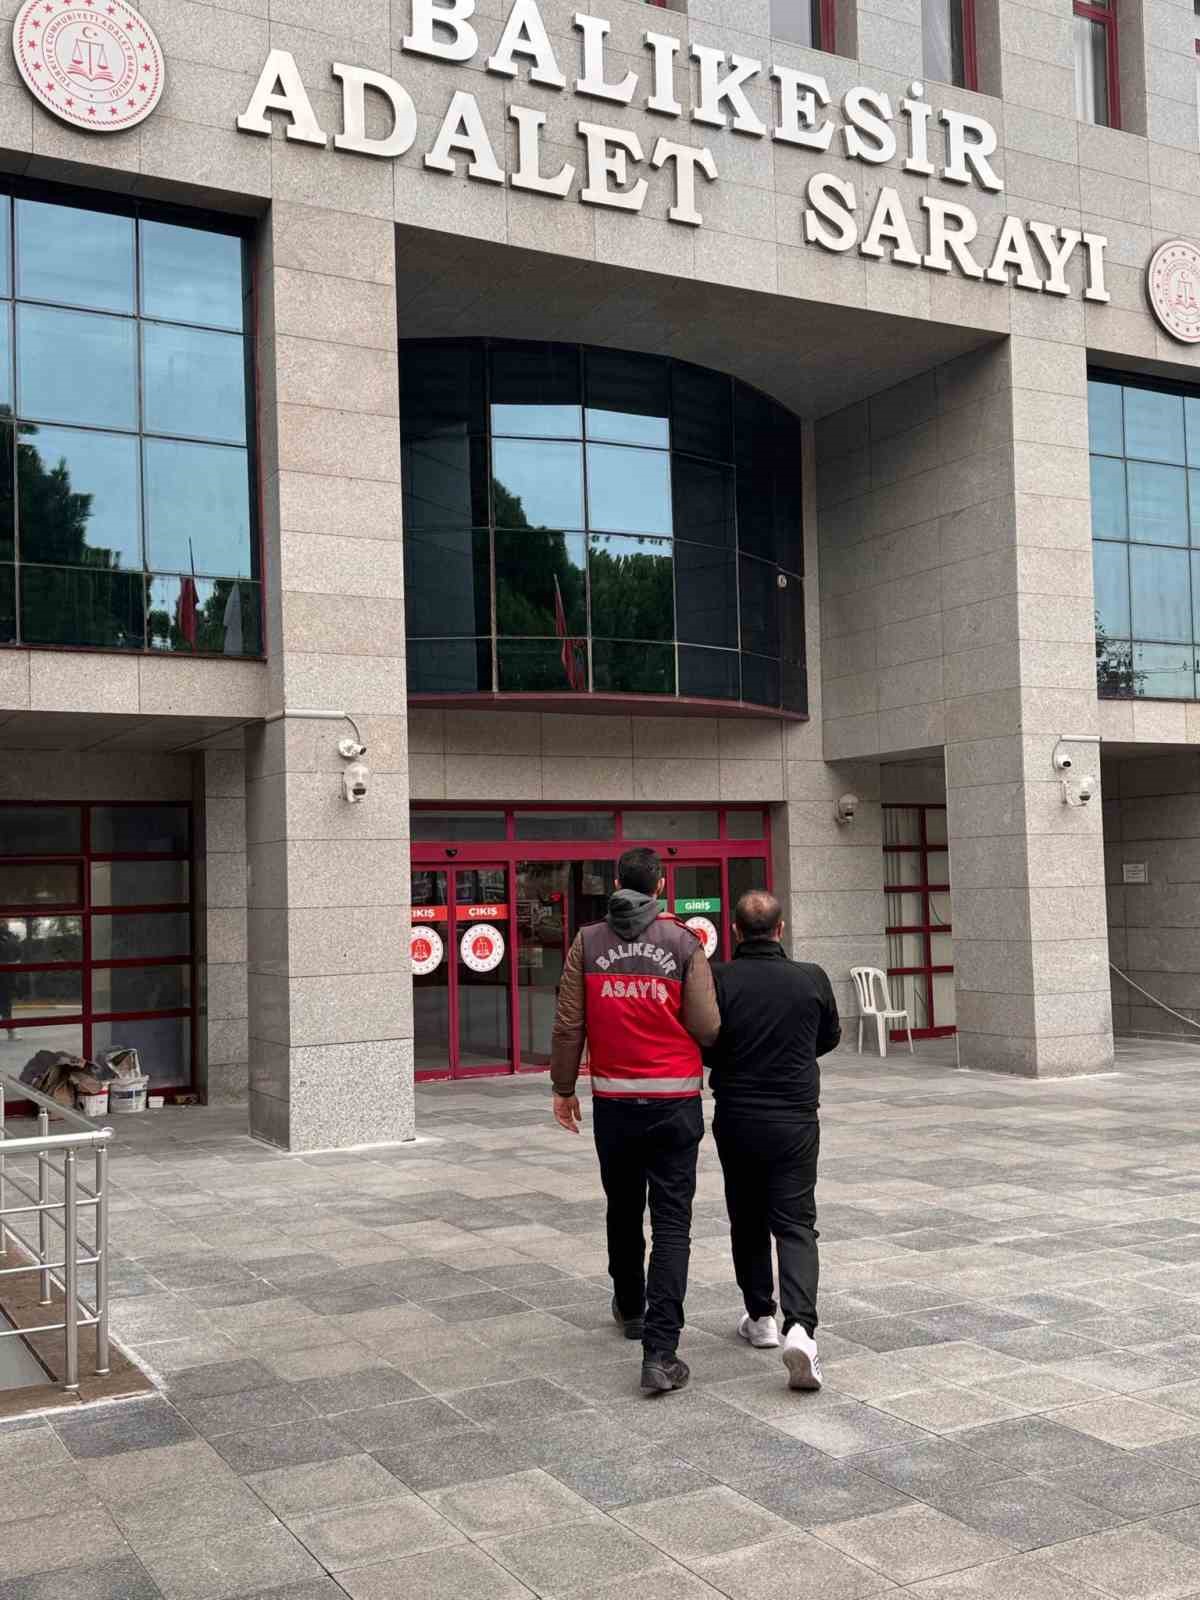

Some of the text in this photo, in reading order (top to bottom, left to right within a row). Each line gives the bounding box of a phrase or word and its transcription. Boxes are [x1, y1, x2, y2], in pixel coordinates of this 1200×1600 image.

[402, 0, 1004, 192] BALIKESİR
[236, 48, 1111, 303] ADALET SARAYI
[411, 908, 436, 918] IKIŞ
[595, 942, 678, 974] BALIKESİR
[600, 978, 669, 1005] ASAYİŞ
